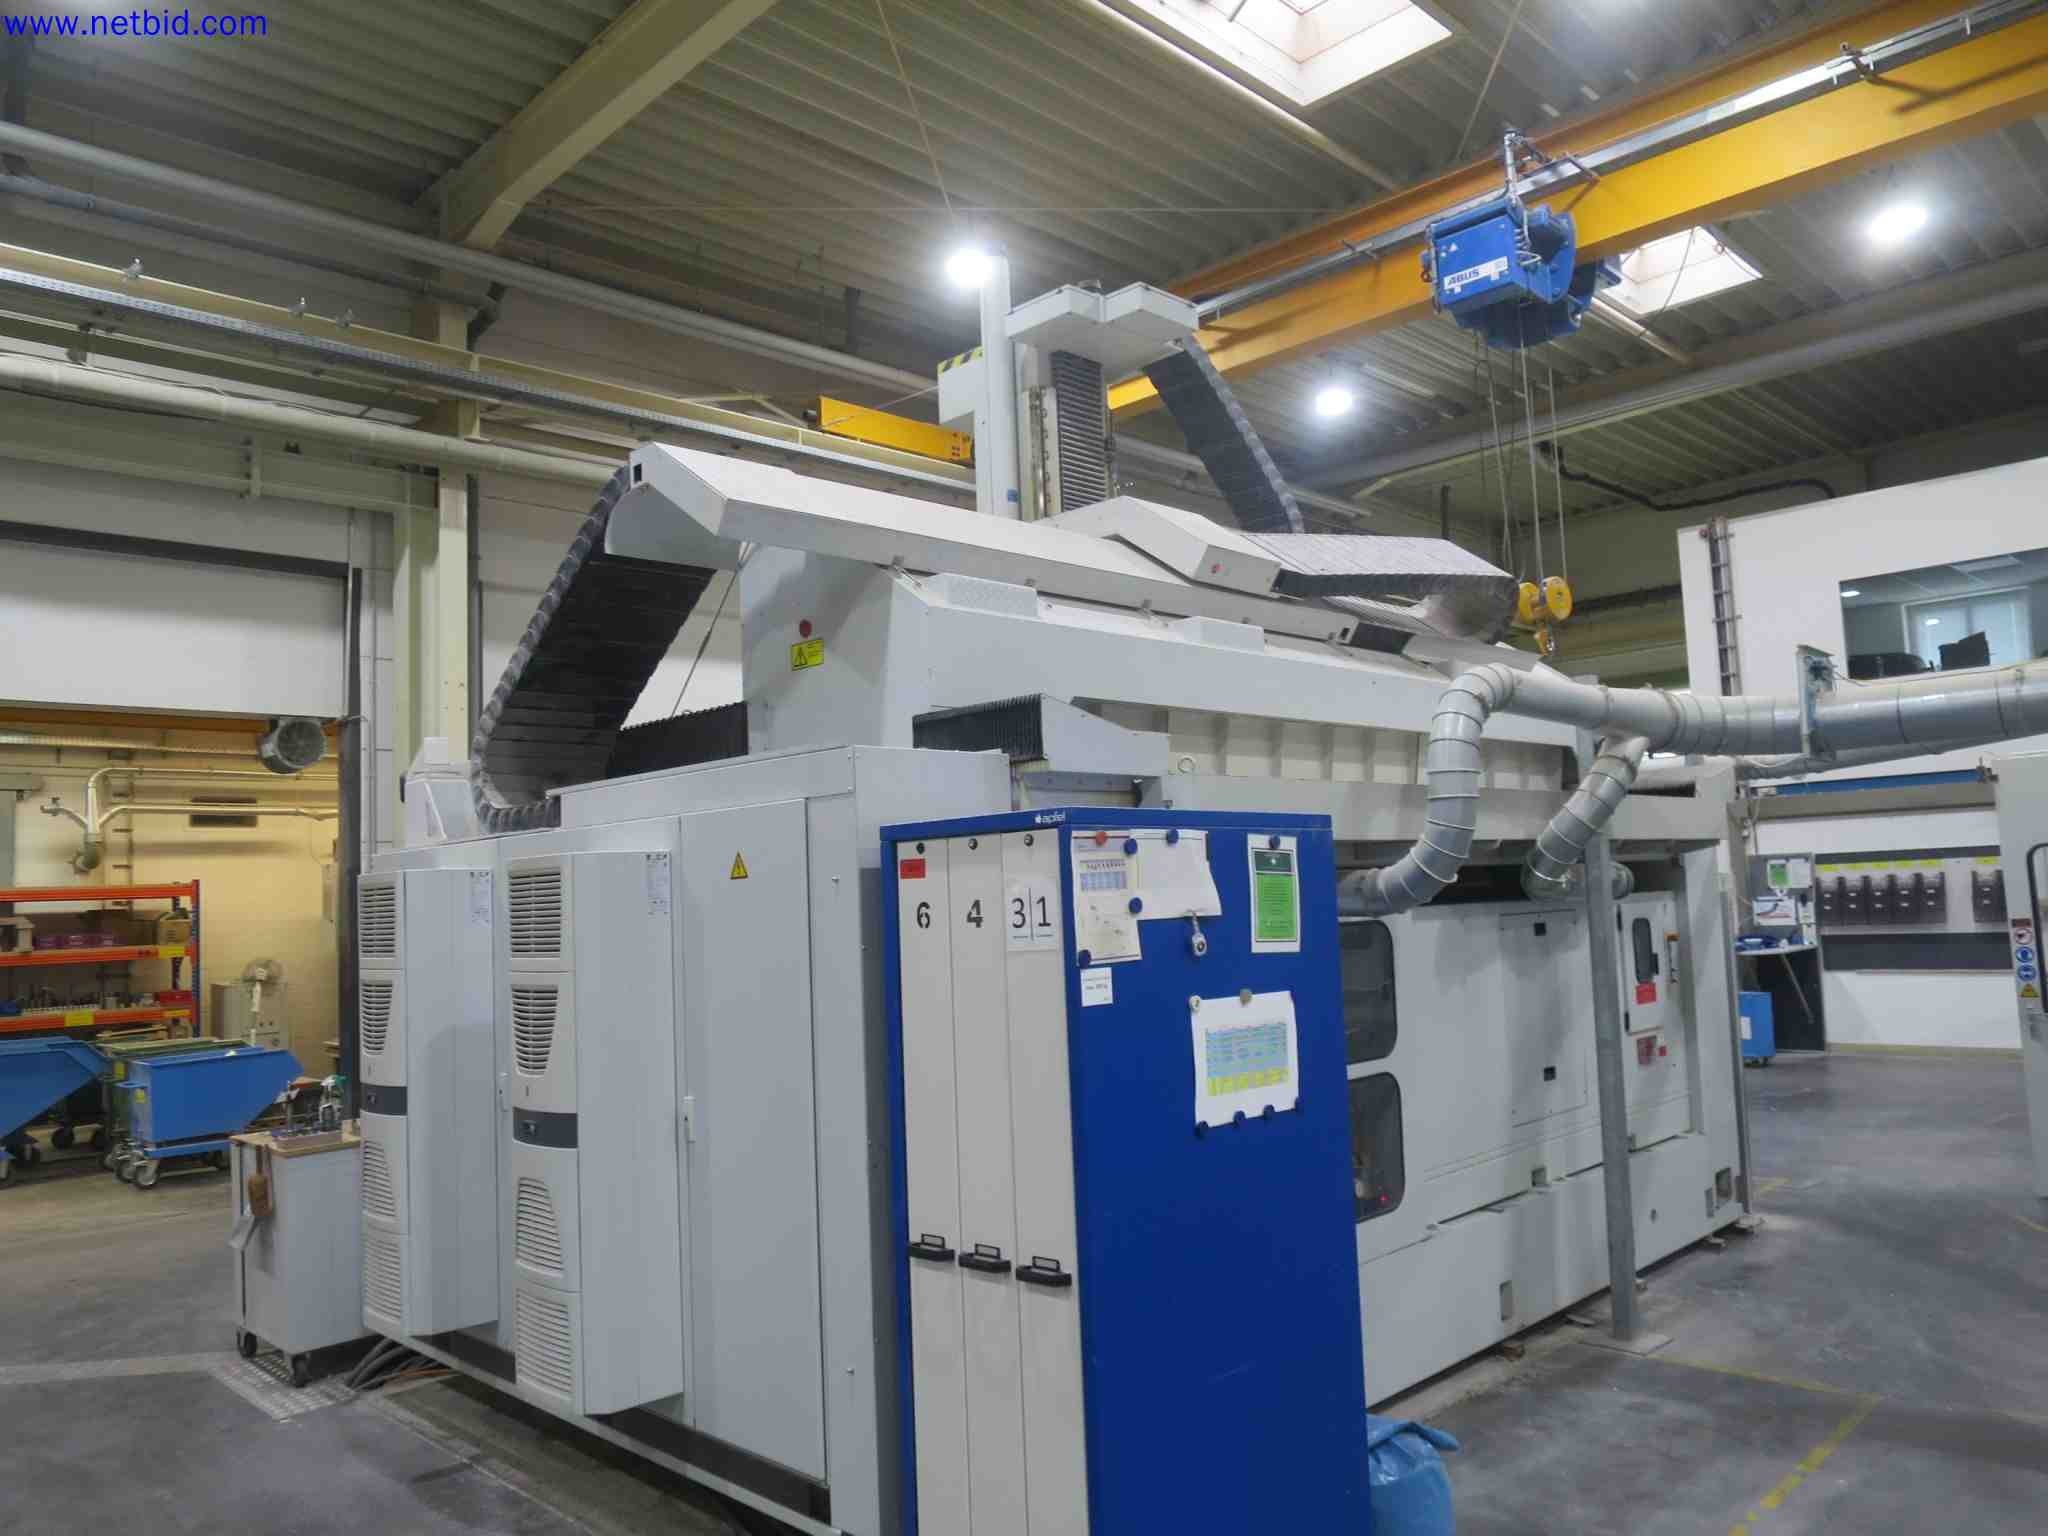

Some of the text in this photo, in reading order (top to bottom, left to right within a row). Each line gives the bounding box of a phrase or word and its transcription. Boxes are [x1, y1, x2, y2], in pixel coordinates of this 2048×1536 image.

[1447, 269, 1480, 286] ABUS
[916, 901, 931, 929] 6
[966, 899, 984, 929] 4
